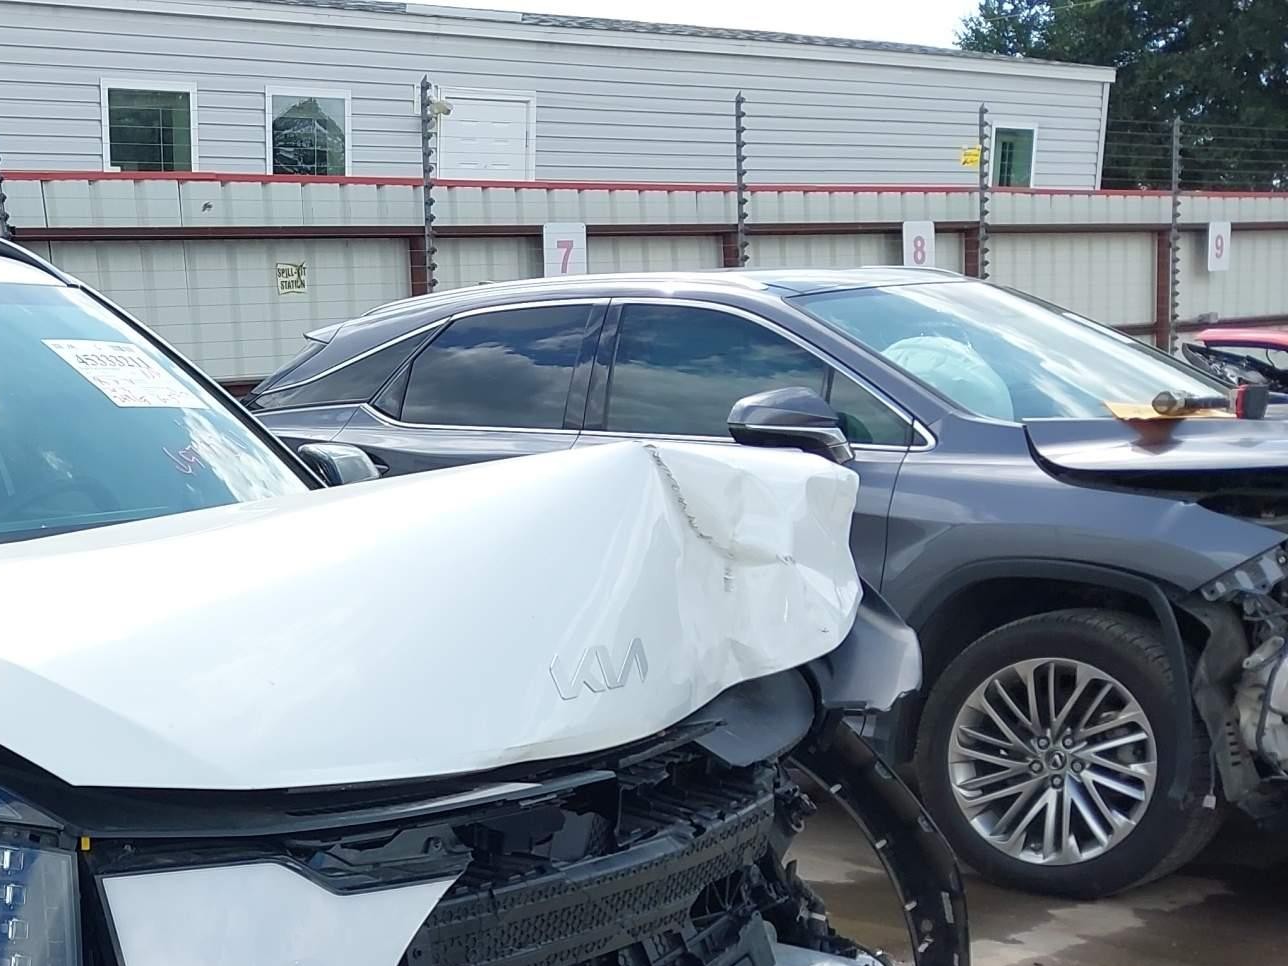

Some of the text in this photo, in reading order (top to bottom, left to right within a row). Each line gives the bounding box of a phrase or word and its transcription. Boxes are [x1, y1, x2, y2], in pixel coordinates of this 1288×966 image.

[556, 239, 574, 274] 7
[913, 235, 926, 265] 8
[1215, 234, 1224, 259] 9
[75, 353, 151, 369] 45333211
[548, 637, 649, 702] KIA
